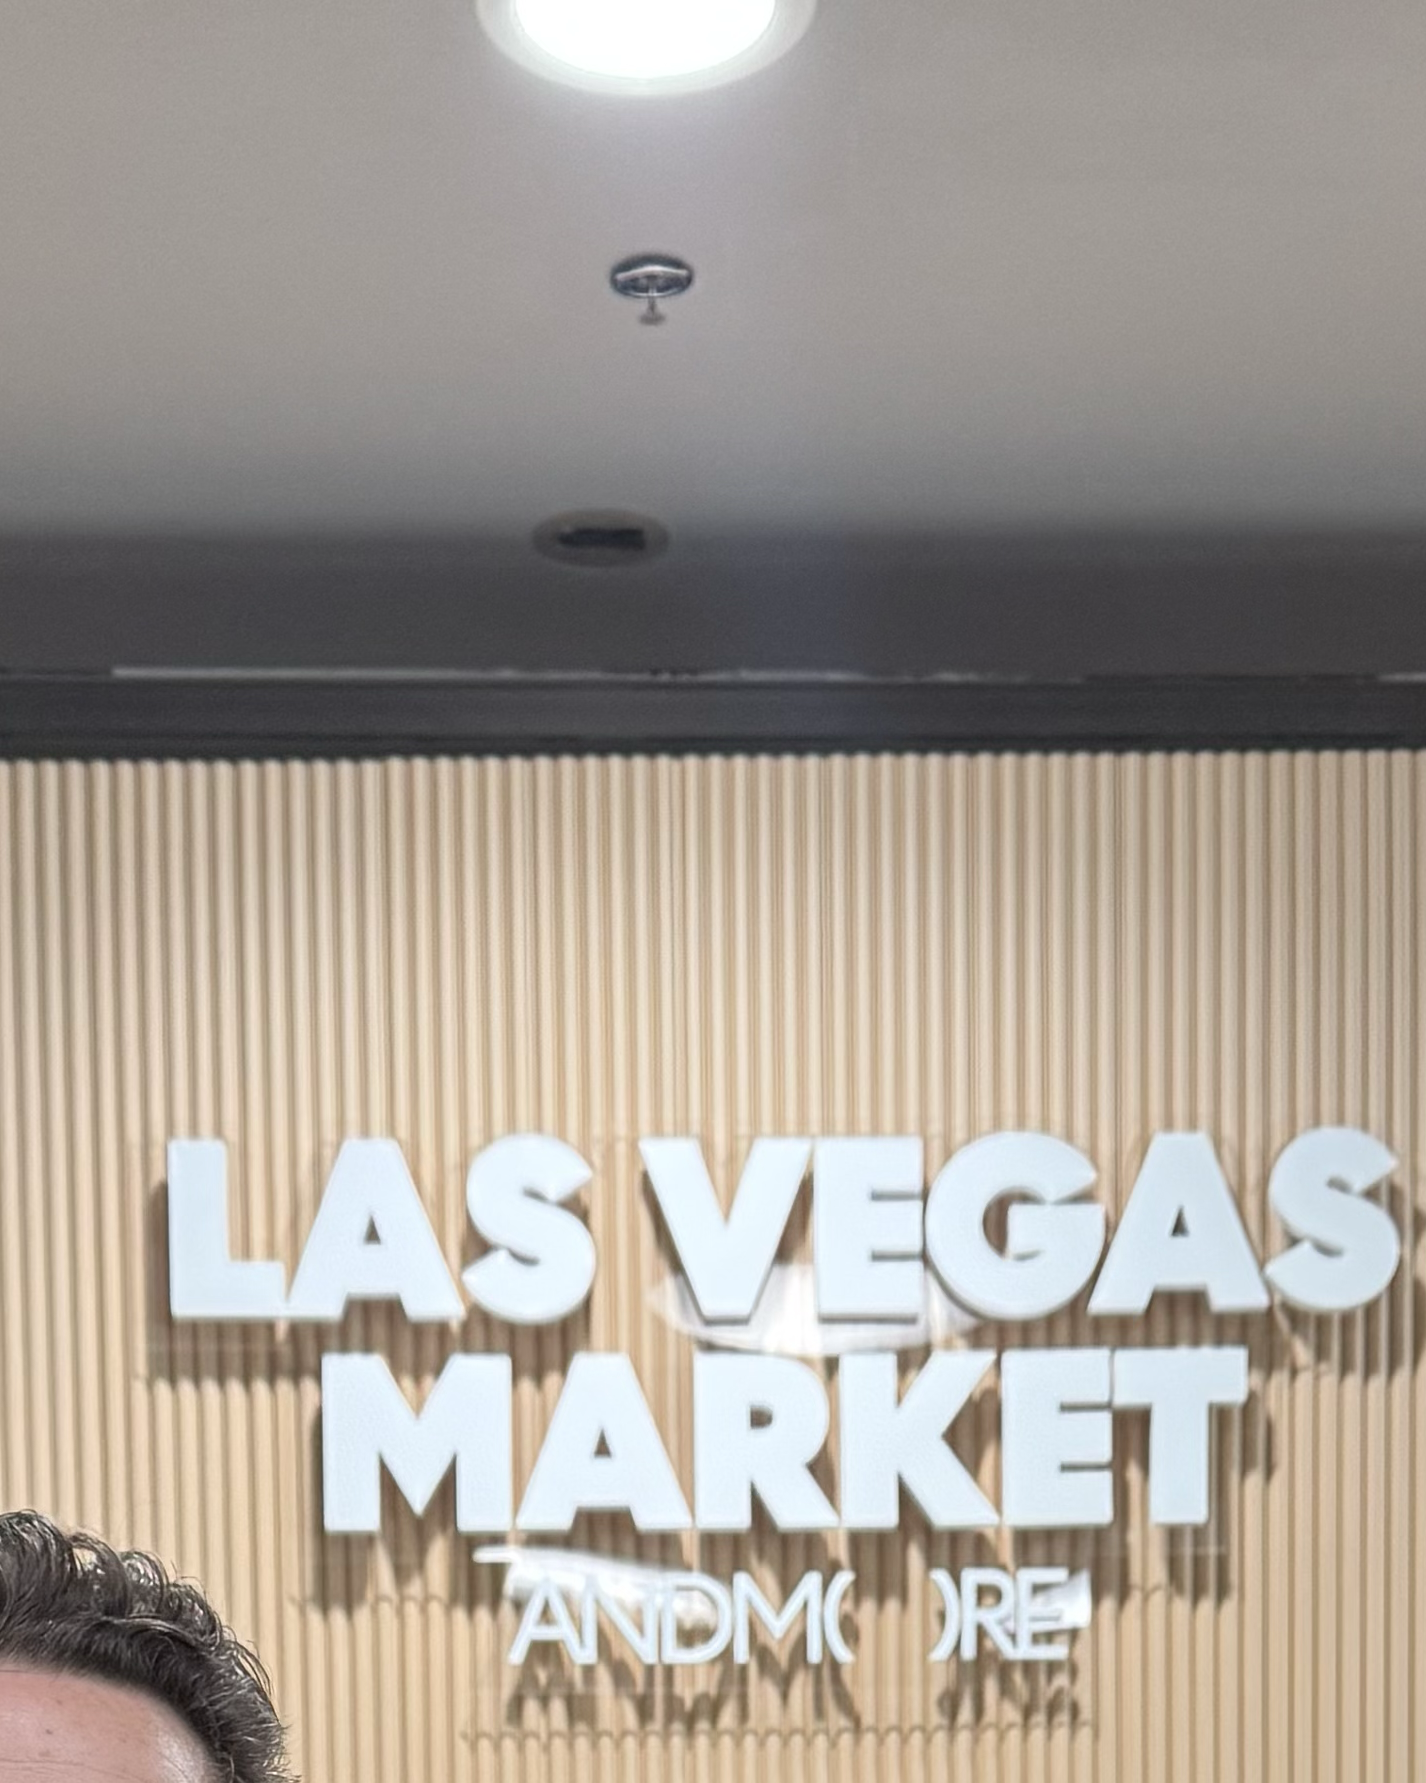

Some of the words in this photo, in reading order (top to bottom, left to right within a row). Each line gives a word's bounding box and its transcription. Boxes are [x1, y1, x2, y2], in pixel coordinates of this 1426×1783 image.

[168, 1131, 598, 1324] LAS
[639, 1125, 1404, 1323] VEGAS
[320, 1345, 1249, 1533] MARKET
